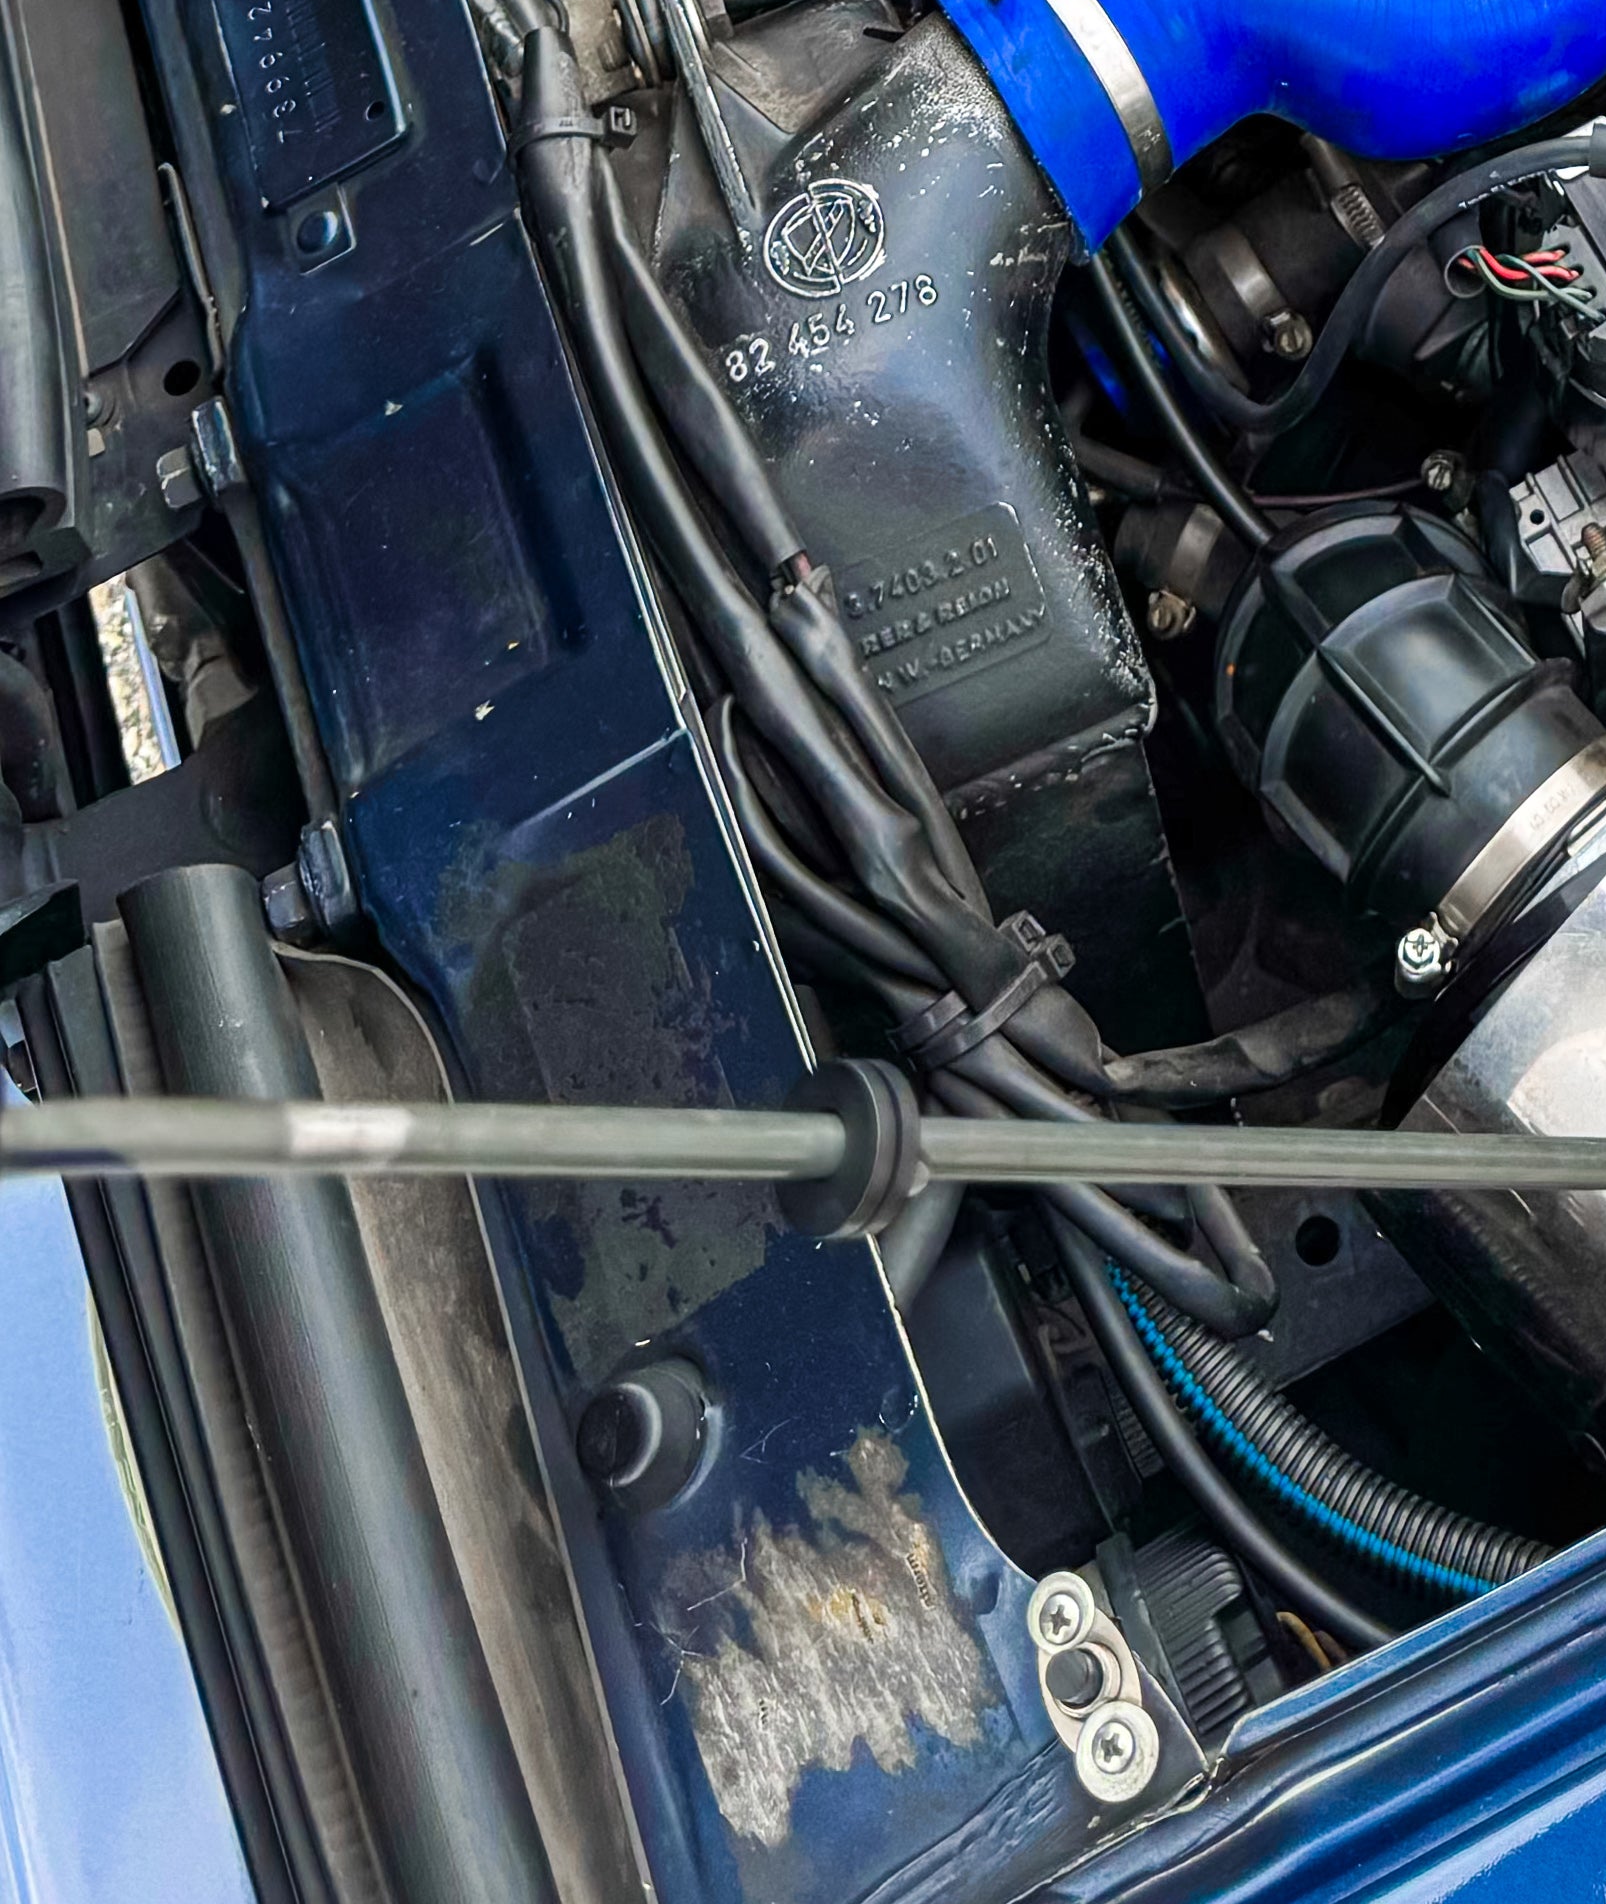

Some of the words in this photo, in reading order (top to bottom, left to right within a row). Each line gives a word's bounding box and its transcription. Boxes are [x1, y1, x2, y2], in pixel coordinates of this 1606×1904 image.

[726, 338, 775, 382] 82
[788, 304, 855, 358] 454
[867, 275, 937, 323] 278
